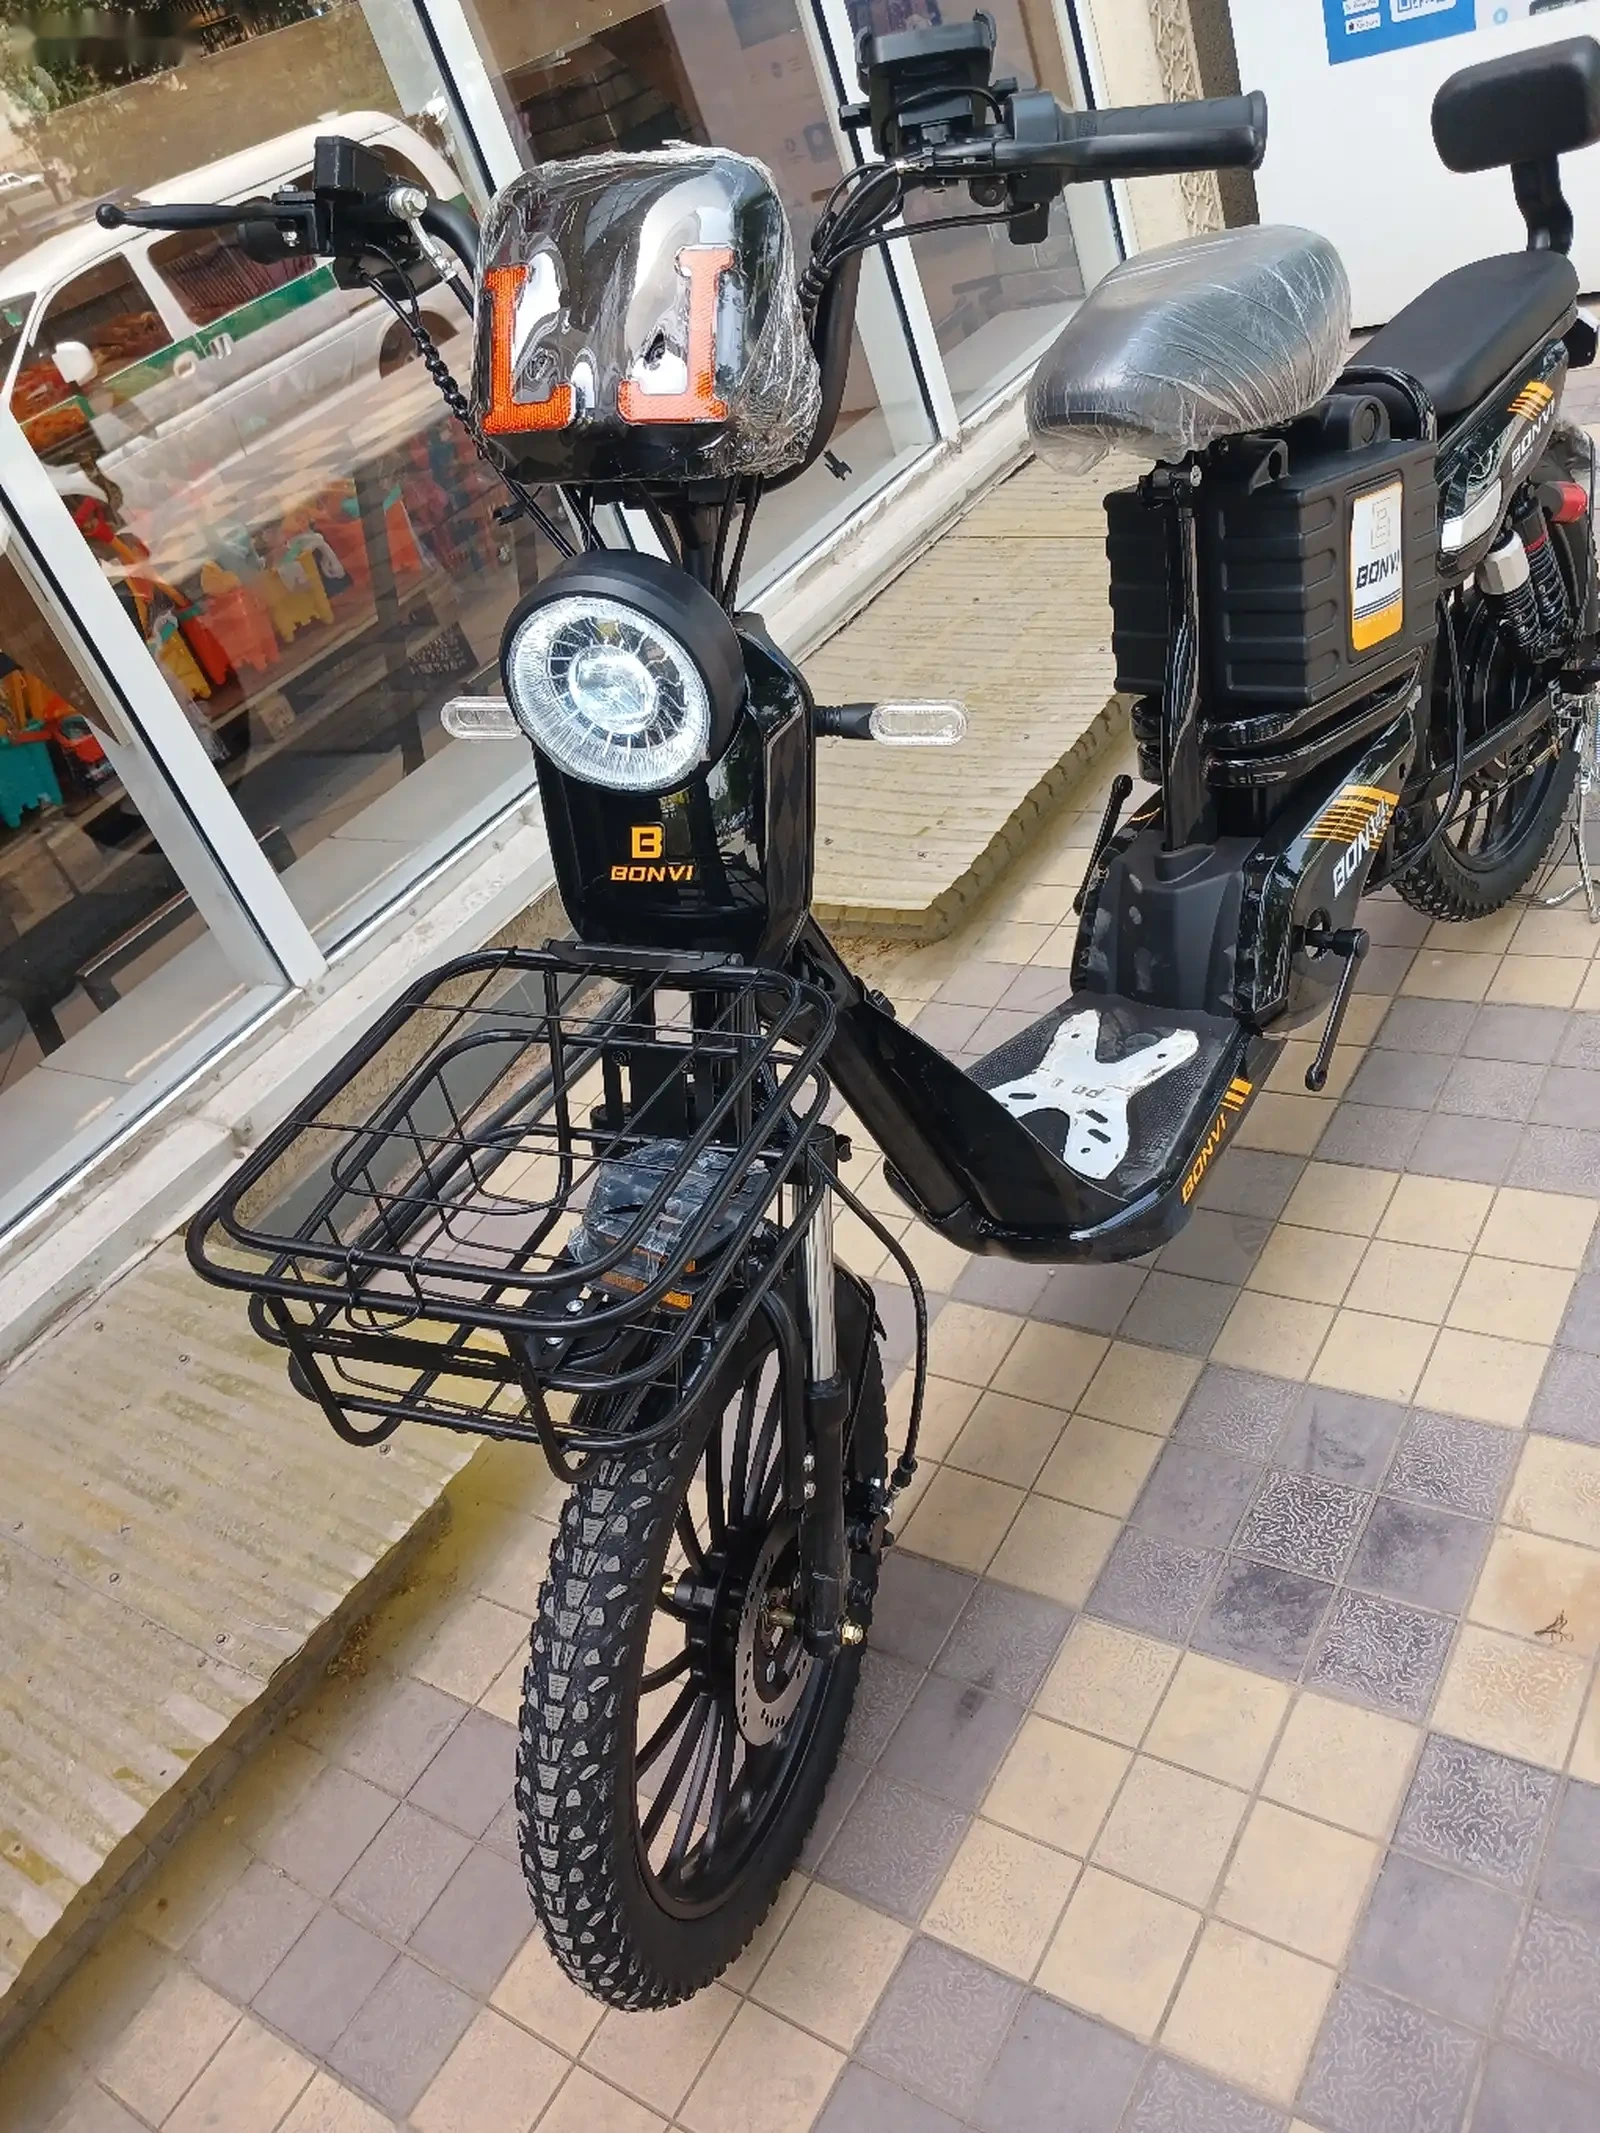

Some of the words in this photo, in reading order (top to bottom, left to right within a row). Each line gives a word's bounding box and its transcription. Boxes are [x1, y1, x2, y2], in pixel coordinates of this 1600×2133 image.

[1511, 397, 1555, 470] BONVI
[1355, 549, 1400, 590] BONVI
[630, 826, 663, 859] B
[610, 865, 694, 882] BONVI
[1182, 1112, 1227, 1206] BONVI
